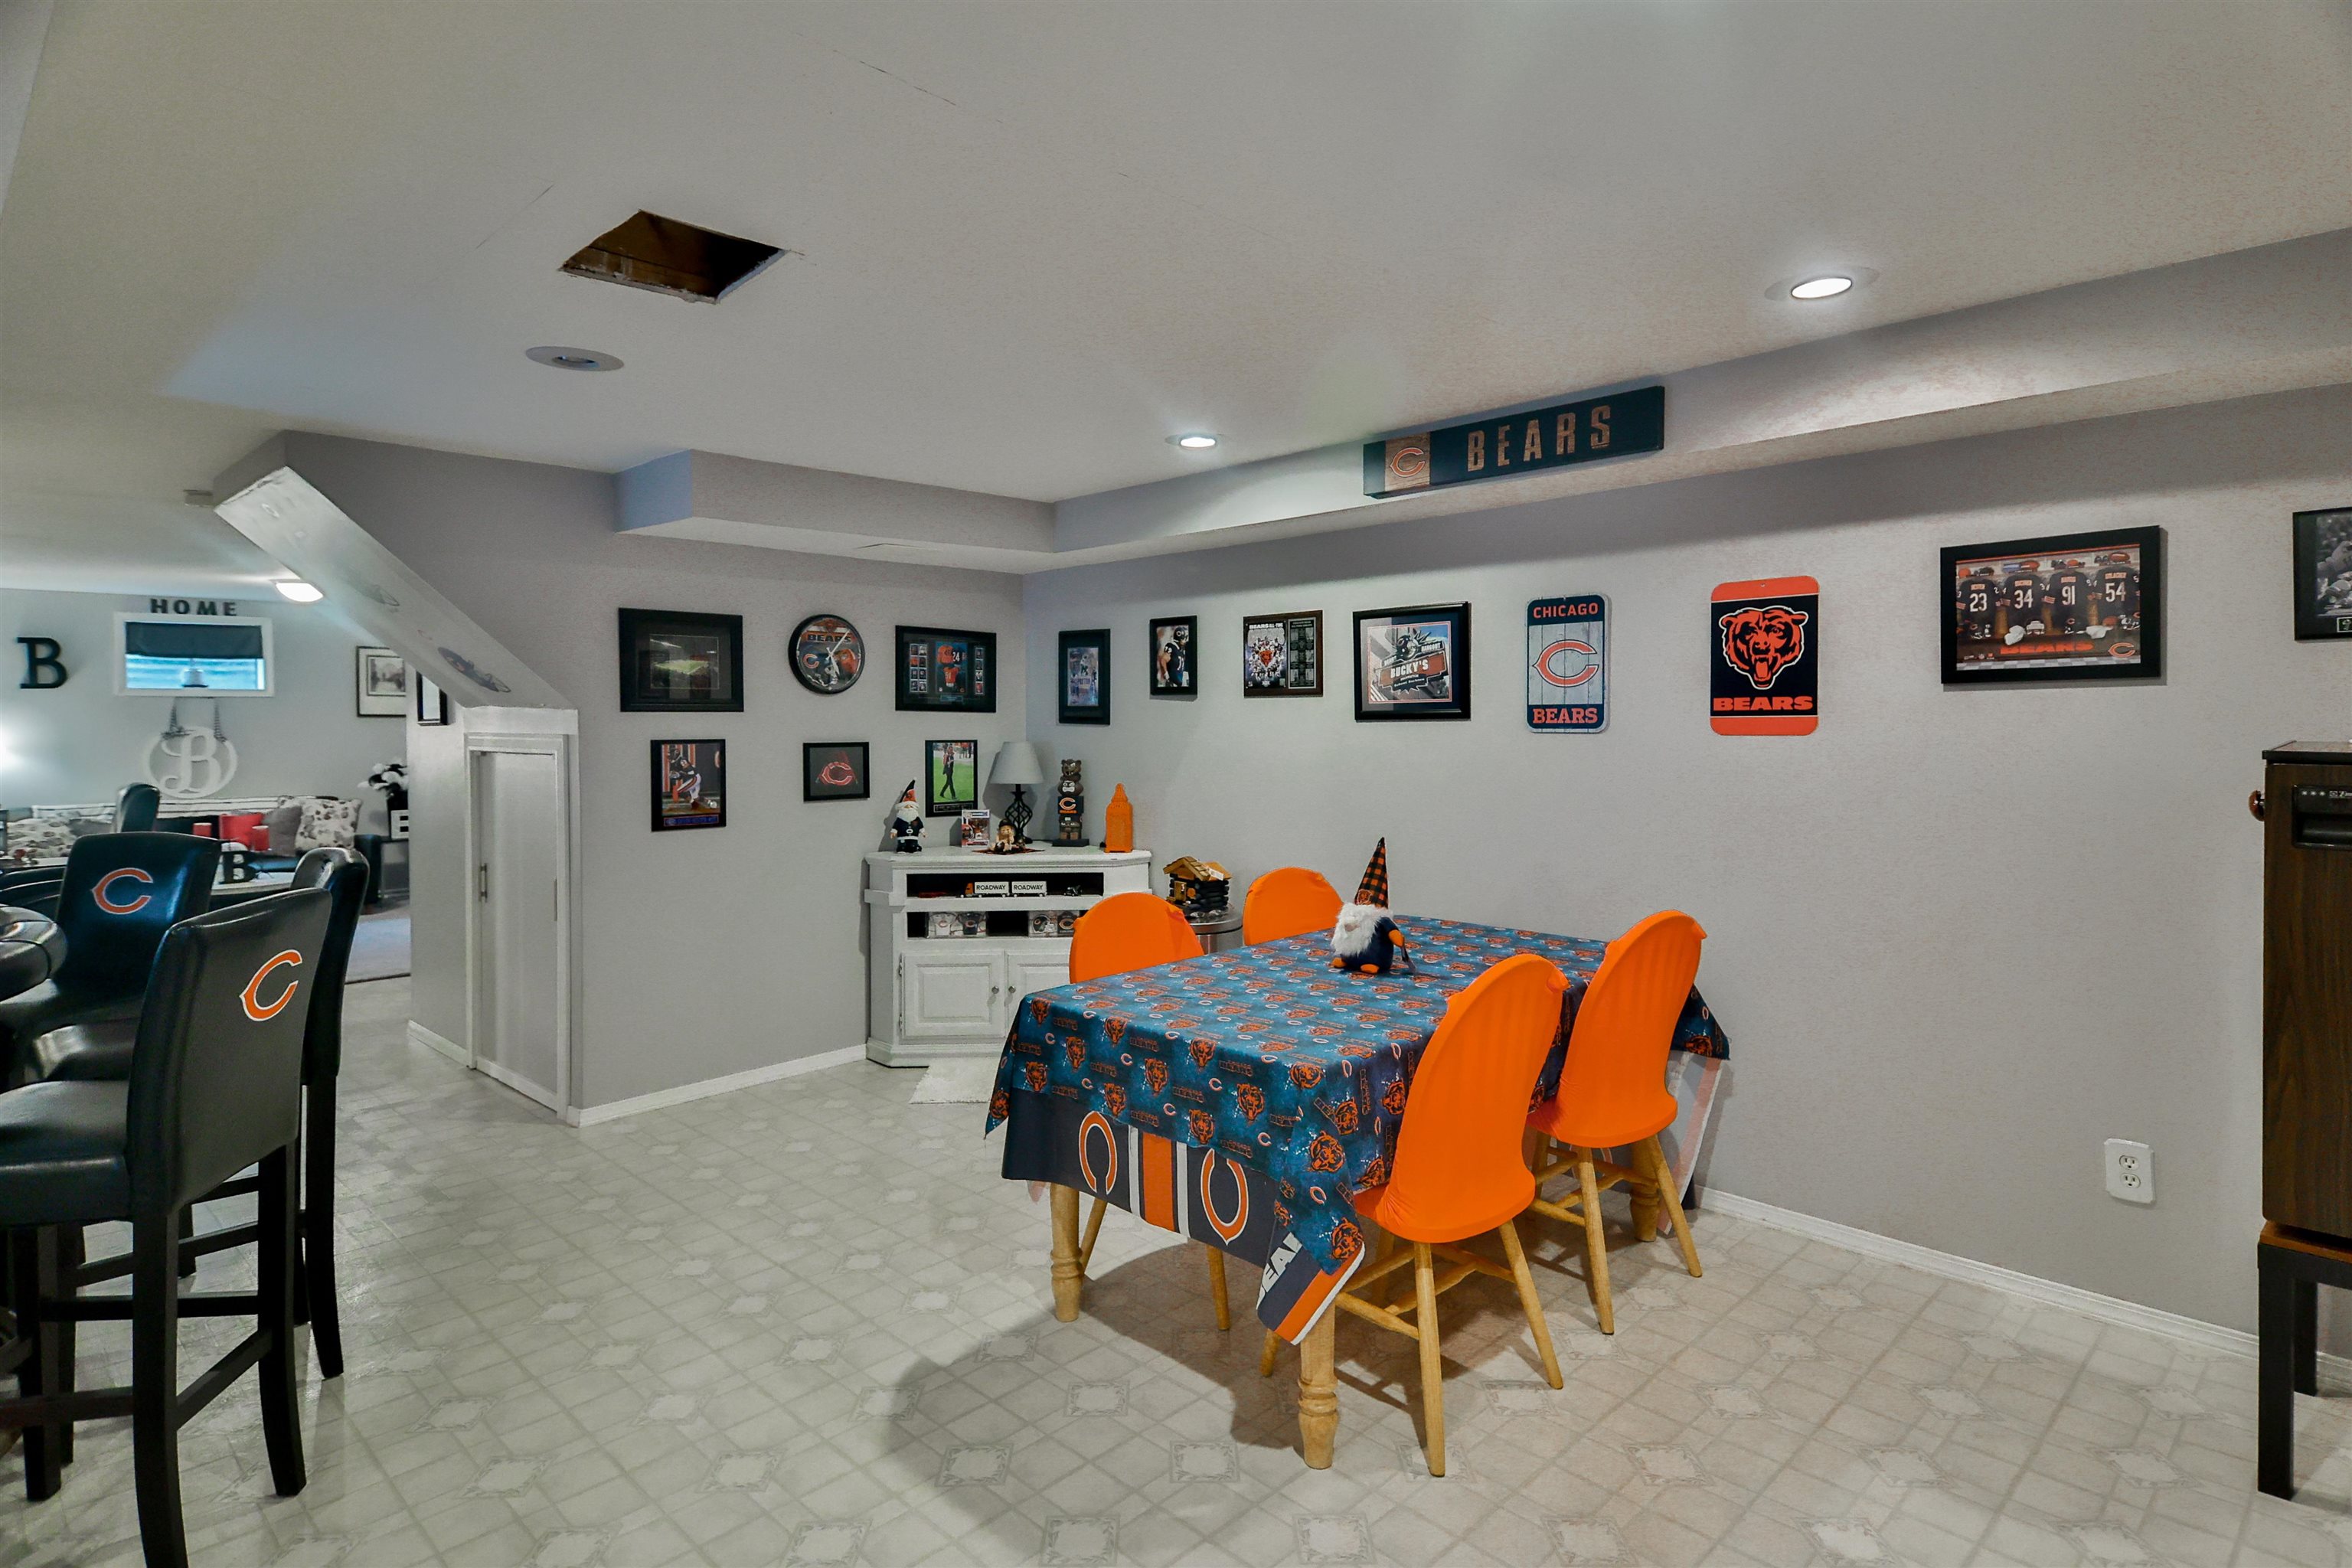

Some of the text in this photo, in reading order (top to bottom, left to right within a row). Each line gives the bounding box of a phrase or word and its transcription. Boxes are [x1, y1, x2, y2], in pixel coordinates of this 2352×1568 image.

[1466, 404, 1612, 472] BEARS
[2014, 589, 2034, 609] 34
[2061, 585, 2076, 606] 91
[2105, 582, 2126, 602] 54
[150, 599, 237, 616] HOME
[1533, 602, 1599, 618] CHICAGO
[1969, 593, 1988, 612] 23
[806, 633, 853, 644] BEARS
[17, 636, 68, 689] B
[1390, 658, 1429, 678] BUCKY'S
[1713, 696, 1815, 712] BEARS
[1532, 707, 1599, 725] BEARS
